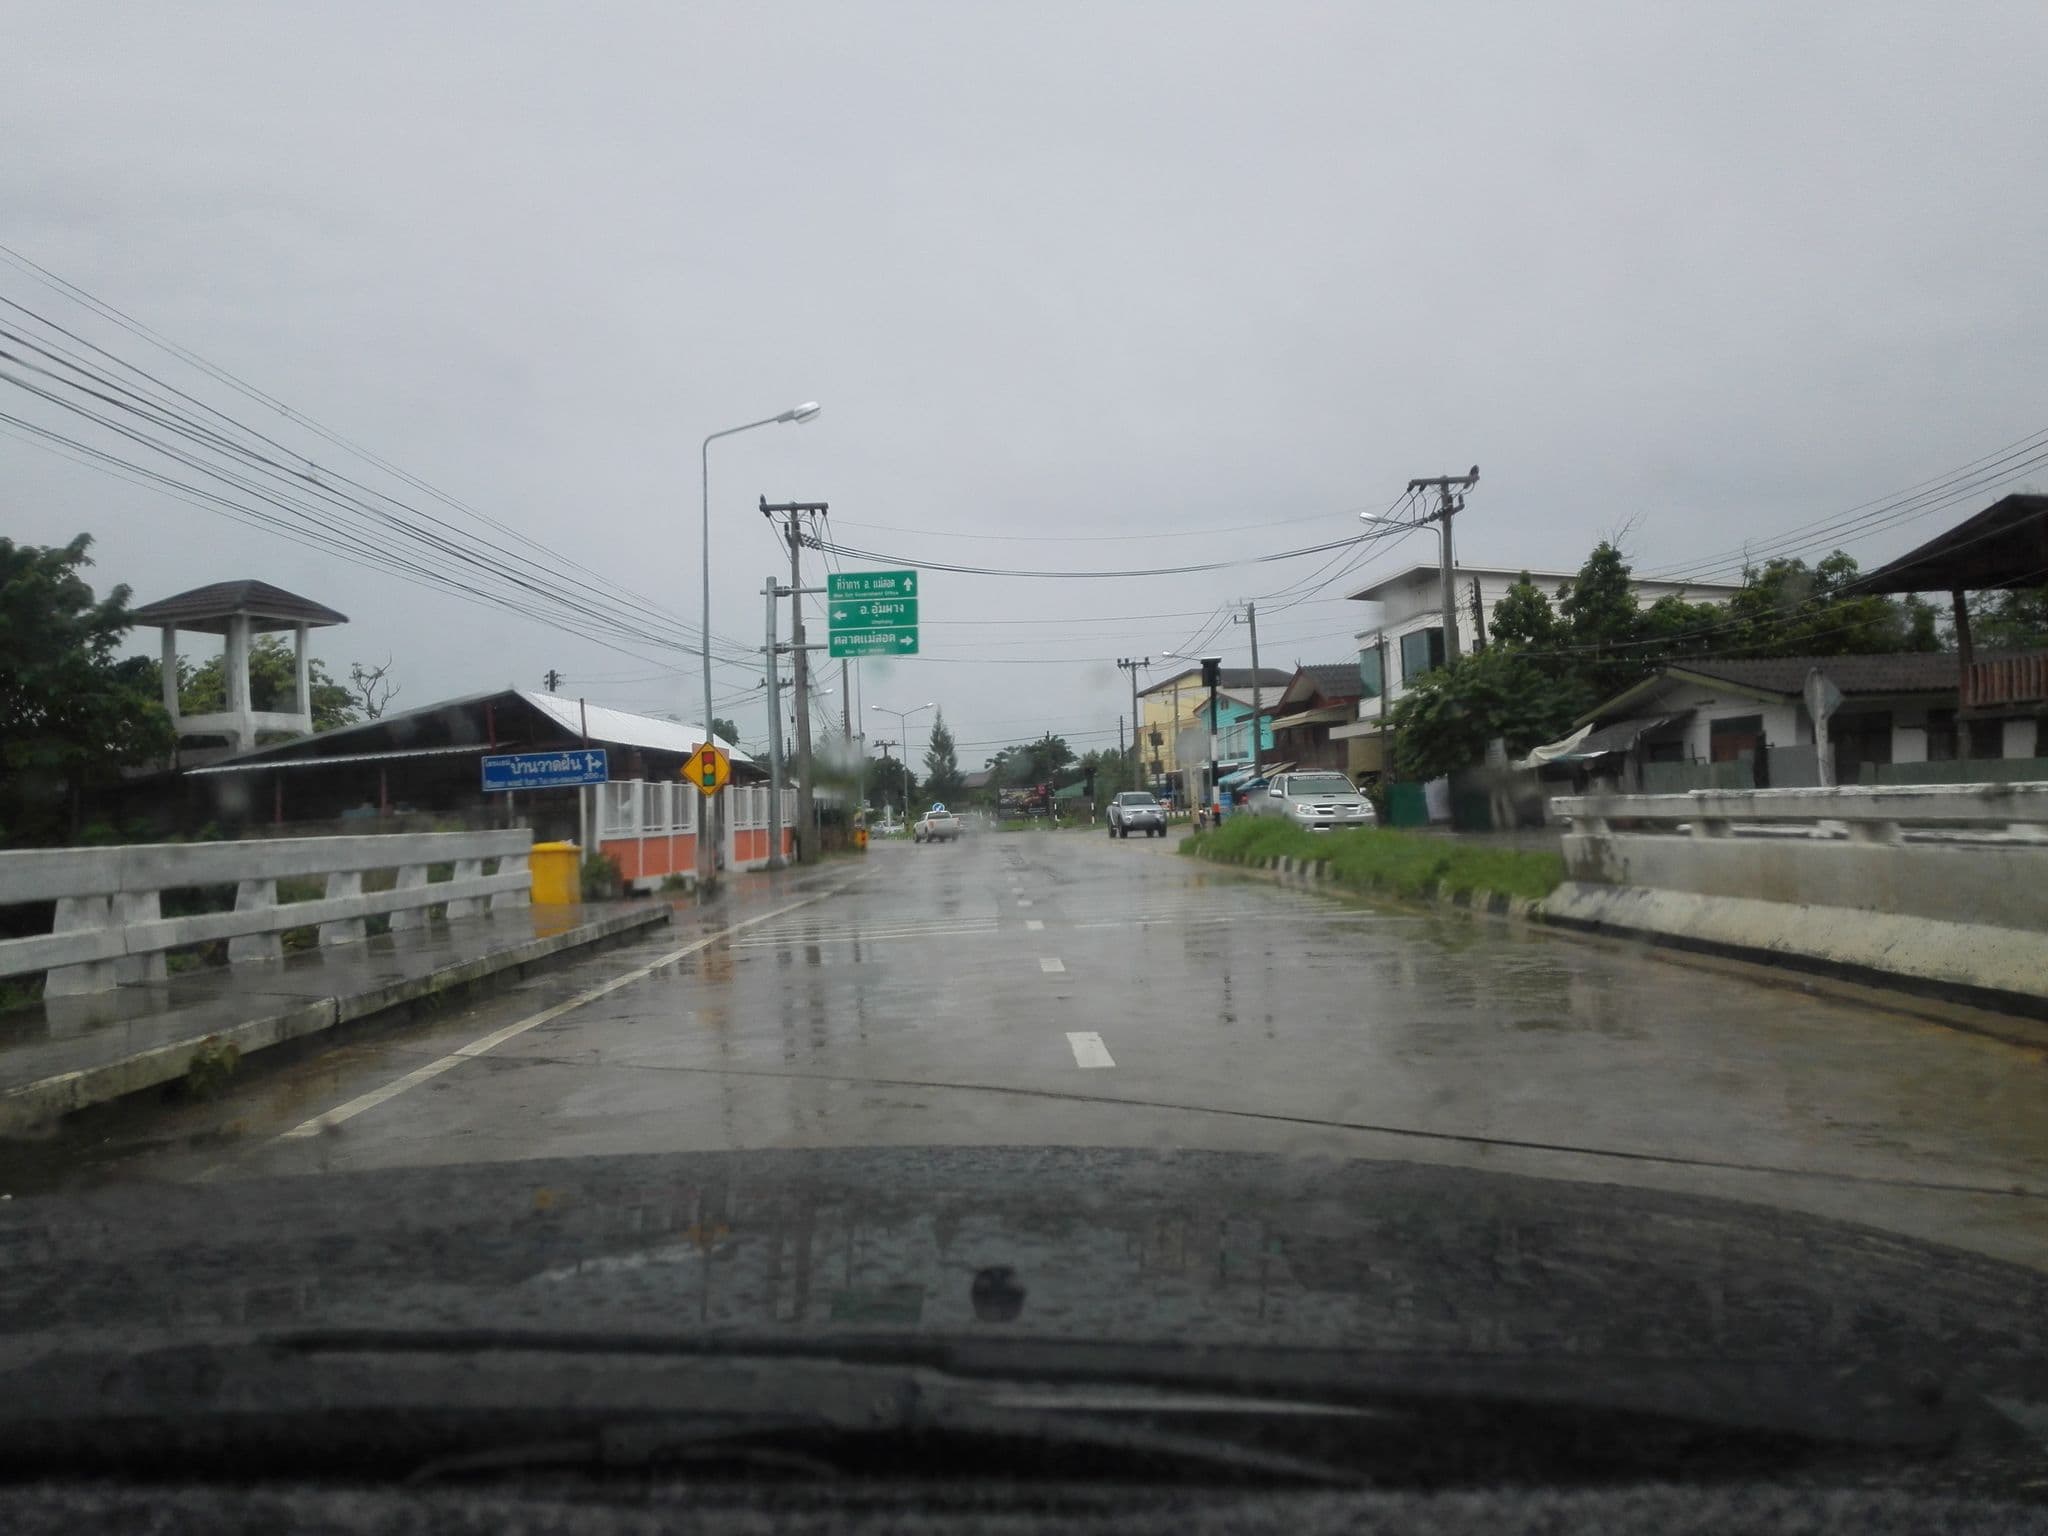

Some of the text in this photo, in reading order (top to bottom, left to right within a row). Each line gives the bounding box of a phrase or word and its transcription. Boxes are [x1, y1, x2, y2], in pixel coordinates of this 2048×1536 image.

[860, 605, 870, 615] อ.
[834, 631, 896, 645] ตลาดแม่สอด
